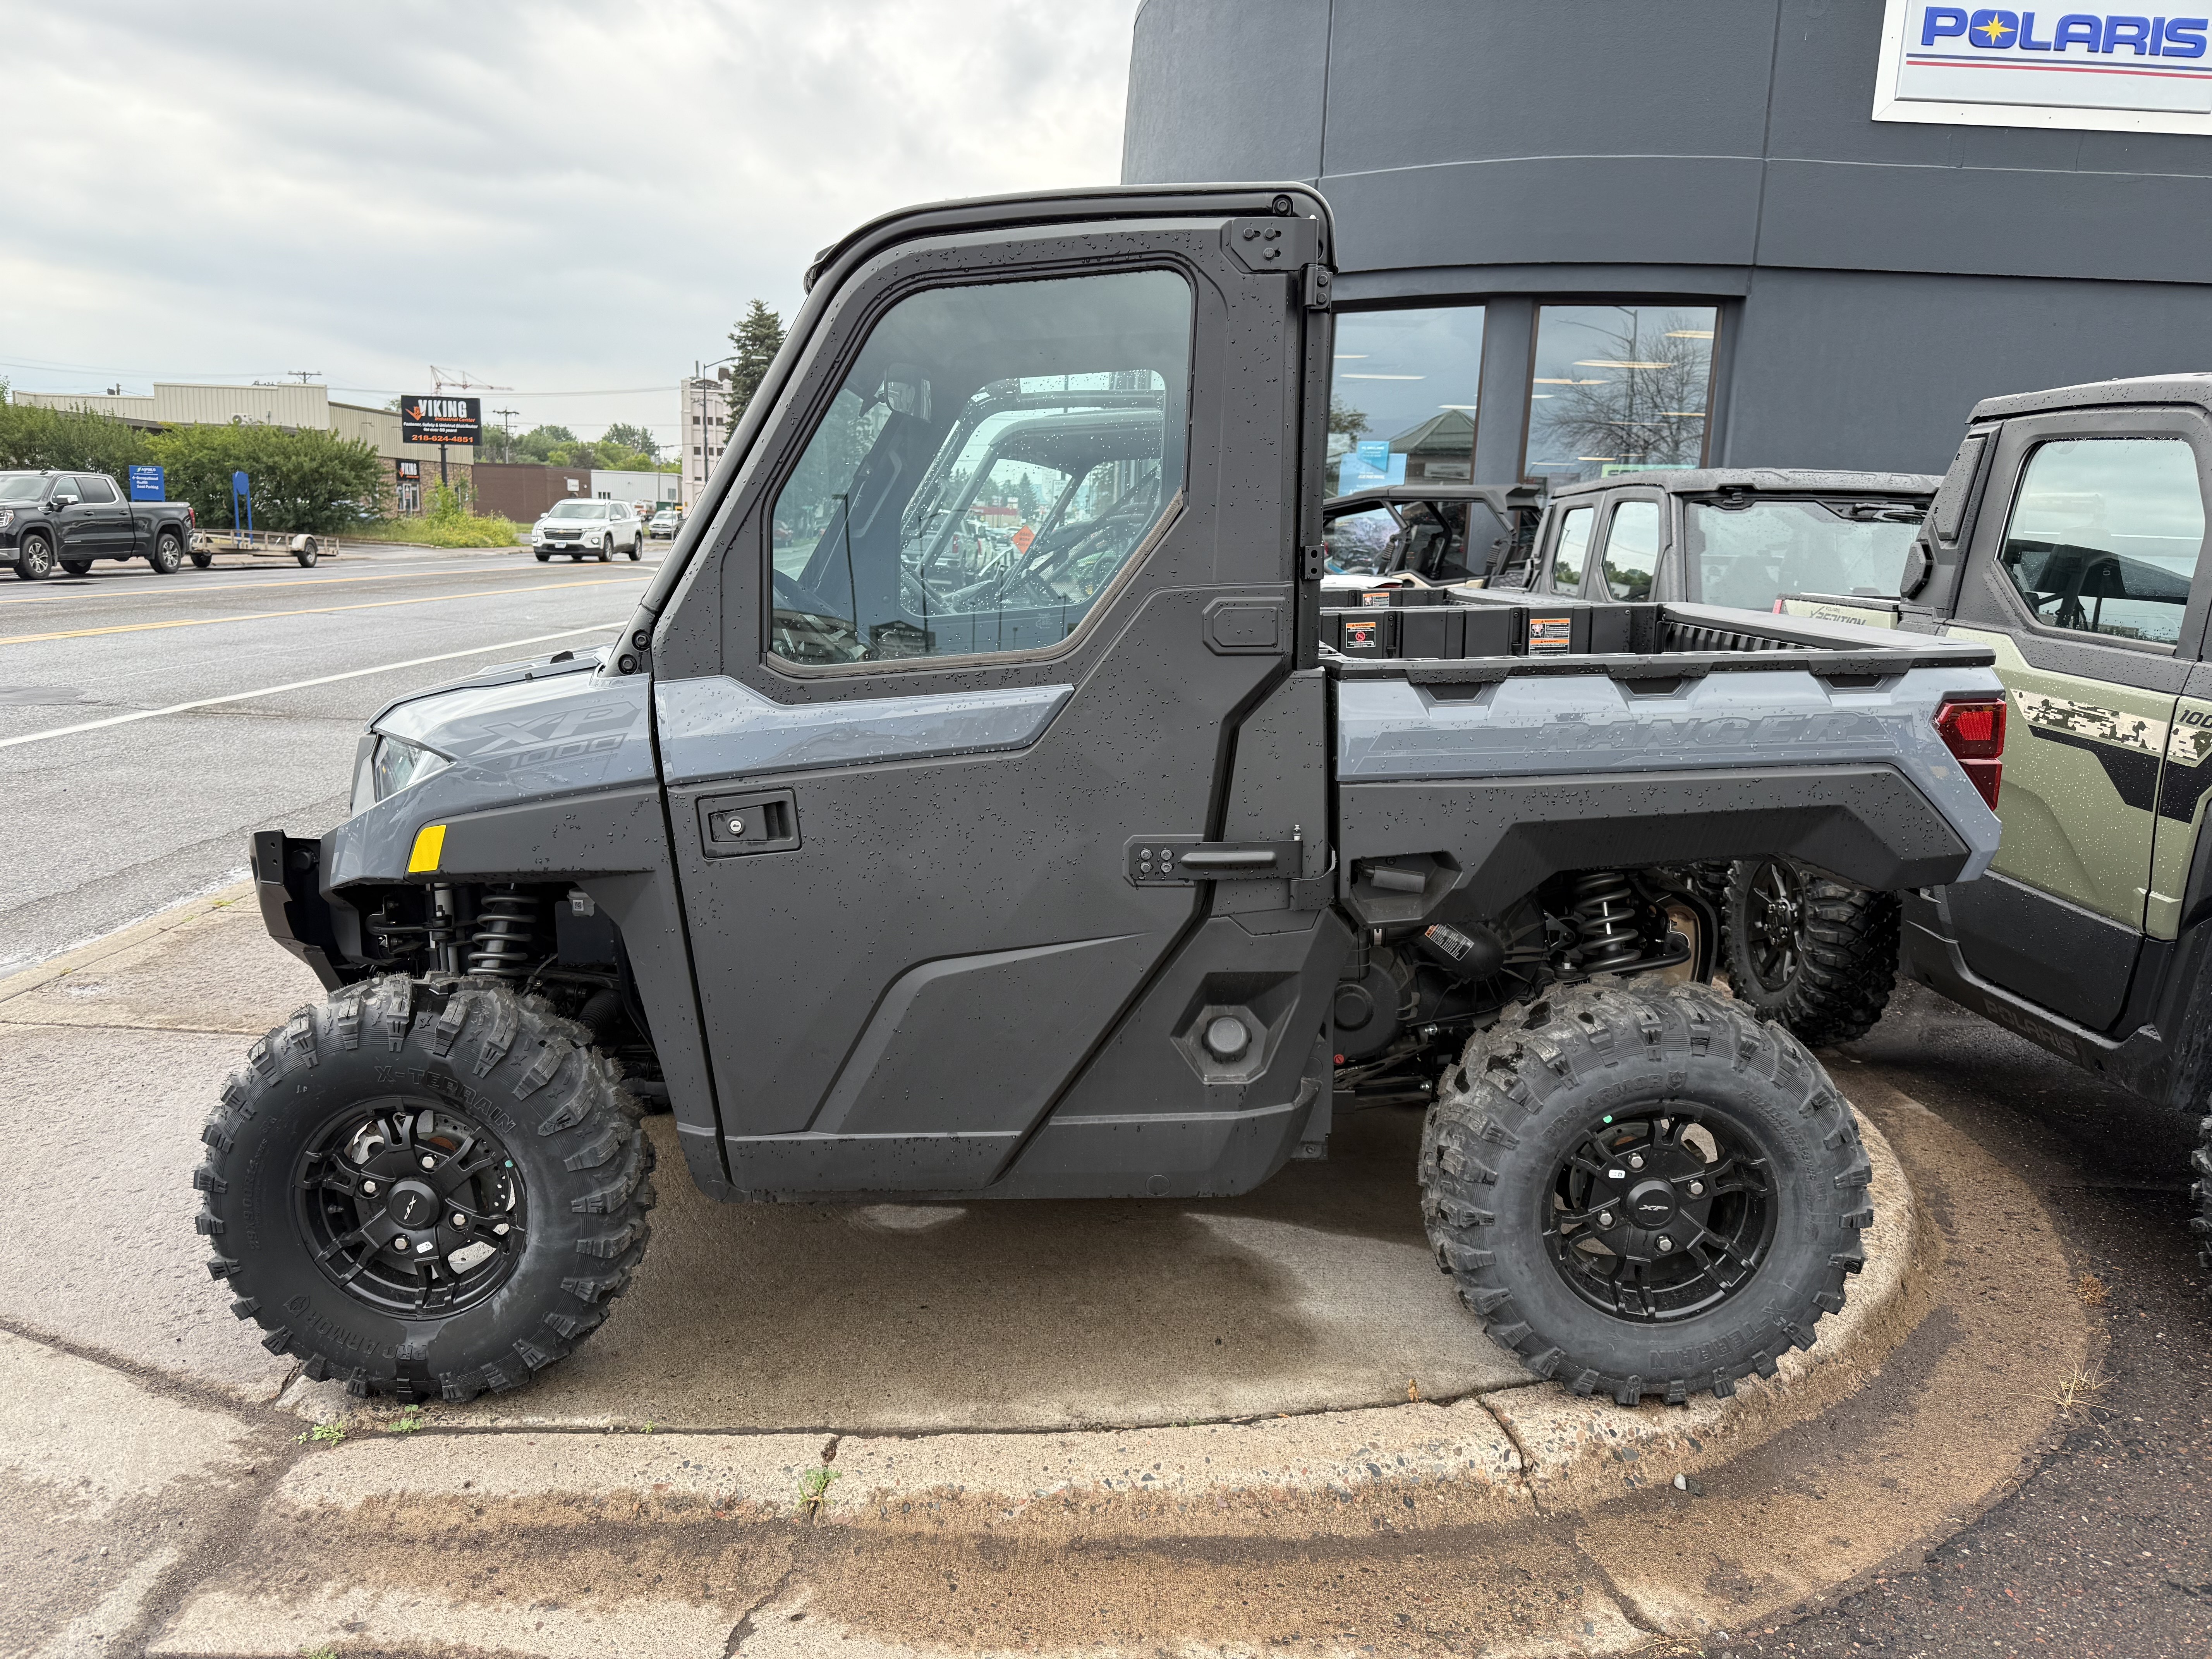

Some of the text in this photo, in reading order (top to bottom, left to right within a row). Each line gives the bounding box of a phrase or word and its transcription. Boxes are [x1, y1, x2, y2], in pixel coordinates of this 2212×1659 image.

[1921, 6, 2209, 58] POLARIS
[418, 399, 467, 418] VIKING
[412, 434, 473, 443] 218-624-4851
[400, 462, 417, 476] VIKING
[465, 701, 642, 757] XP
[509, 735, 623, 769] 1000
[1533, 713, 1861, 750] RANGER
[1983, 997, 2078, 1057] POLARIS
[374, 1066, 516, 1133] X-TERRAIN
[1541, 1073, 1664, 1140] PRO ARMOR
[307, 1309, 427, 1360] PRO ARMOR
[1649, 1298, 1789, 1369] X-TERRAIN
